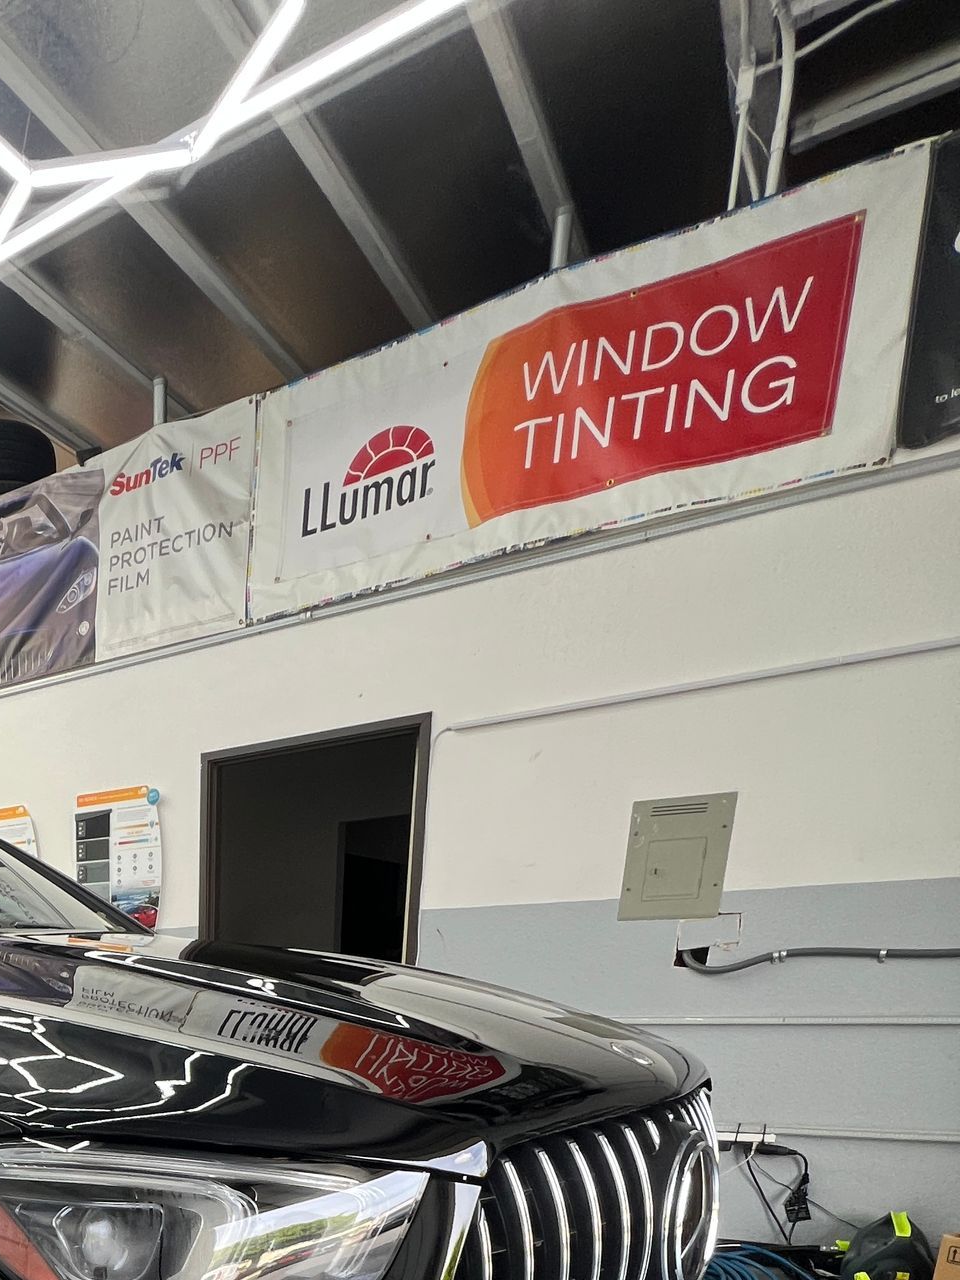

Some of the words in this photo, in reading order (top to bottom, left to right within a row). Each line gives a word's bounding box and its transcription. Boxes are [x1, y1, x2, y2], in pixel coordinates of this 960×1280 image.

[524, 276, 814, 401] WINDOW
[514, 355, 797, 469] TINTING
[110, 452, 185, 496] SunTek
[199, 433, 241, 469] PPF
[302, 459, 435, 537] LLumar
[109, 521, 233, 572] PROTECTION
[110, 516, 165, 548] PAINT
[107, 568, 150, 596] FILM
